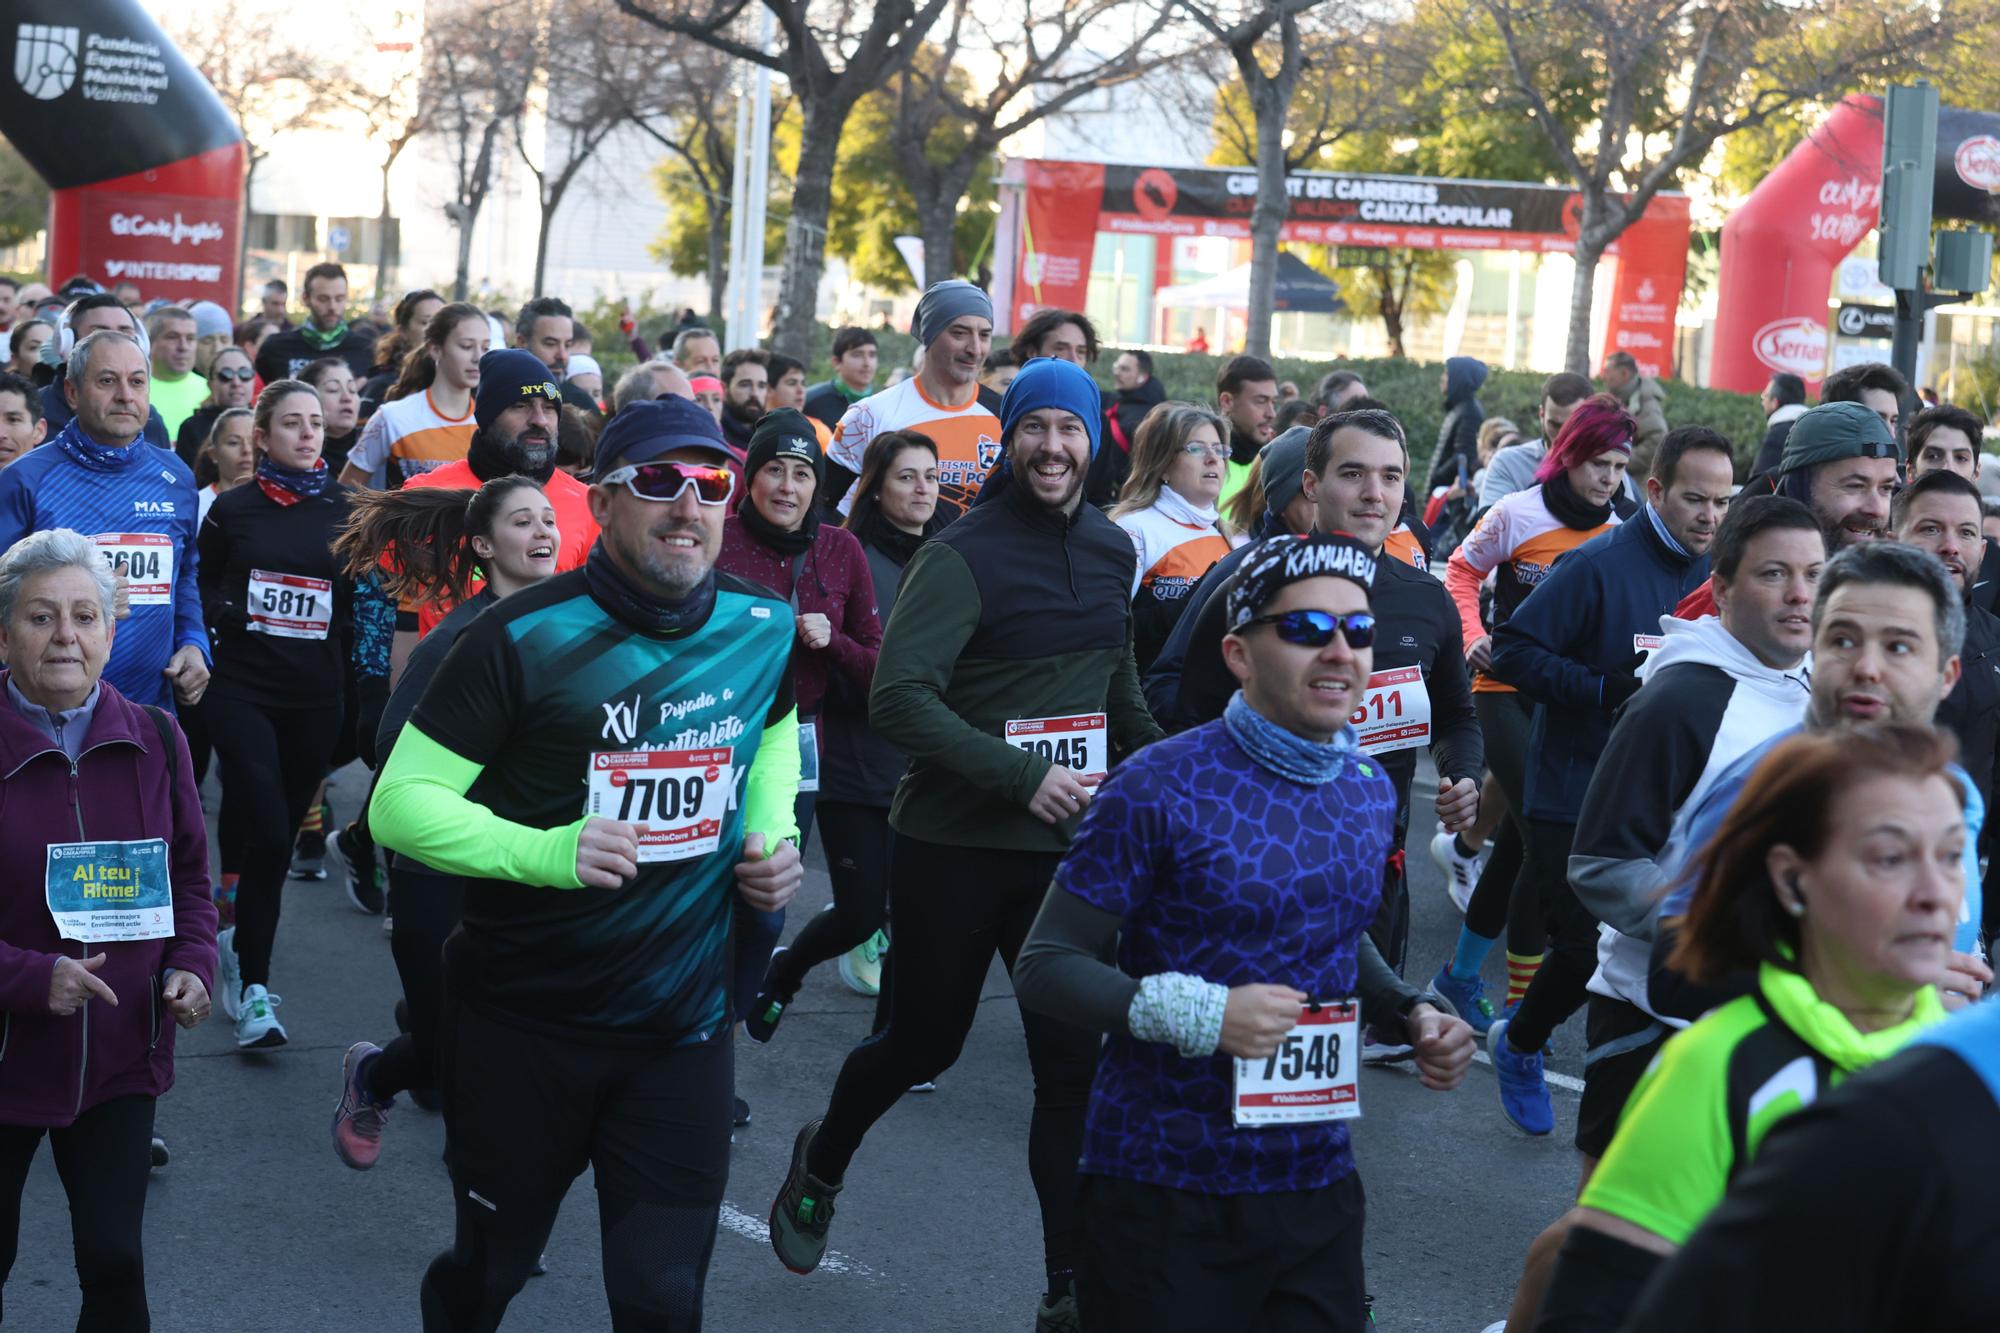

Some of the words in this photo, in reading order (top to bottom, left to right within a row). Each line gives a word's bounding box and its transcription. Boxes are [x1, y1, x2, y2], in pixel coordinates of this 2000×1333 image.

[85, 50, 165, 73] Esportiva
[83, 67, 168, 90] Municipal
[1307, 178, 1334, 198] DE
[1335, 179, 1438, 204] CARRERES
[124, 261, 222, 282] INTERSPORT
[521, 385, 544, 395] NY
[939, 471, 961, 485] DE
[134, 501, 175, 513] MAS
[262, 587, 316, 617] 5811
[601, 693, 641, 744] XV
[660, 691, 717, 725] Pujada
[722, 688, 735, 700] a
[618, 776, 704, 821] 7709
[73, 863, 94, 881] Al
[98, 865, 131, 880] teu
[83, 882, 134, 898] Ritme
[1263, 1033, 1340, 1081] 7548
